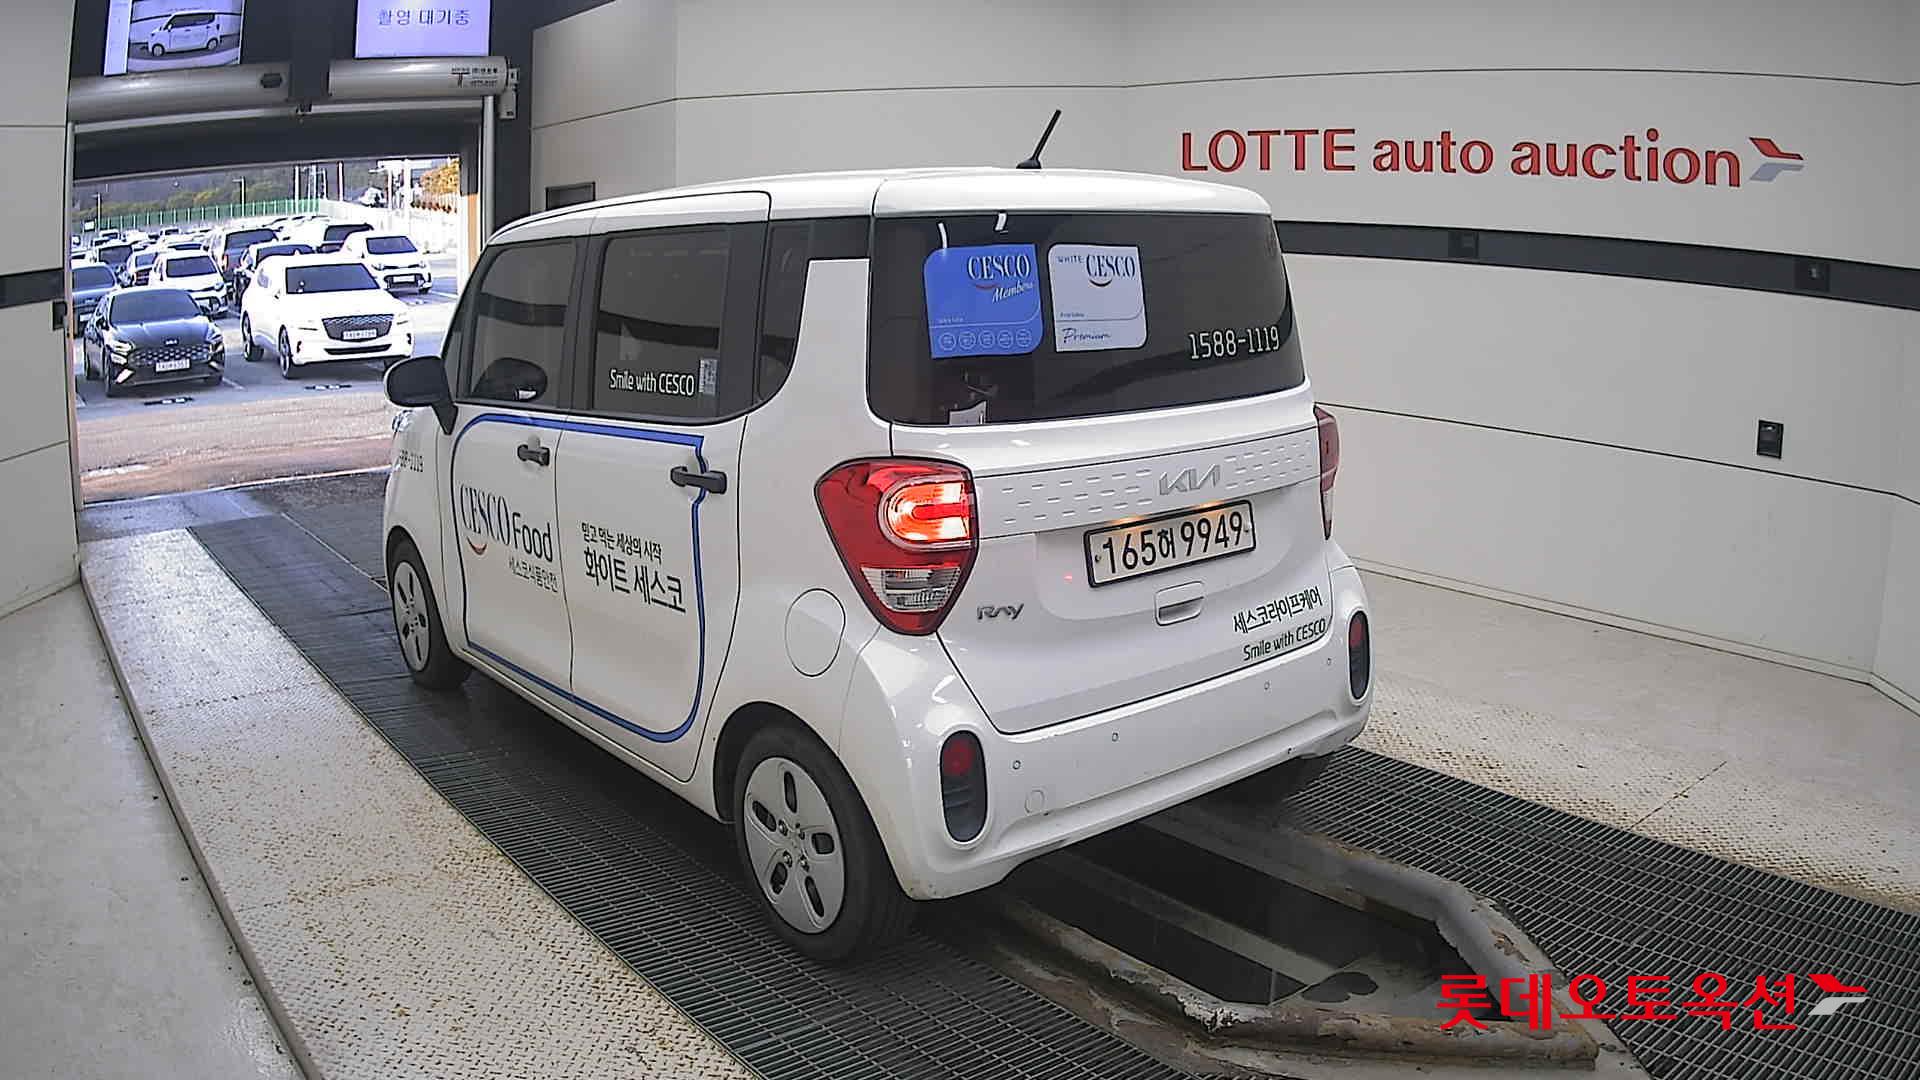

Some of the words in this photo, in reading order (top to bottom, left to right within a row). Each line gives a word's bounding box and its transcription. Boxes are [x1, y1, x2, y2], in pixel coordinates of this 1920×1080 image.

[419, 8, 470, 26] 대기중
[1181, 128, 1356, 173] LOTTE
[1372, 130, 1494, 175] auto
[1511, 128, 1742, 188] auction
[967, 254, 1031, 280] CESCO
[1086, 254, 1136, 277] CESCO
[1188, 325, 1280, 360] 1588-1119
[609, 369, 634, 391] Smile
[635, 371, 657, 393] with
[658, 372, 695, 396] CESCO
[460, 483, 511, 547] CESCO
[512, 511, 553, 563] Food
[581, 521, 598, 543] 믿고
[598, 527, 615, 550] 먹는
[616, 532, 642, 559] 세상의
[643, 540, 662, 565] 시작
[583, 546, 631, 594] 화이트
[633, 564, 686, 614] 세스코
[1233, 585, 1323, 634] 세스코라이프케어
[1243, 640, 1272, 661] Smile
[1273, 630, 1295, 651] with
[1295, 617, 1327, 642] CESCO
